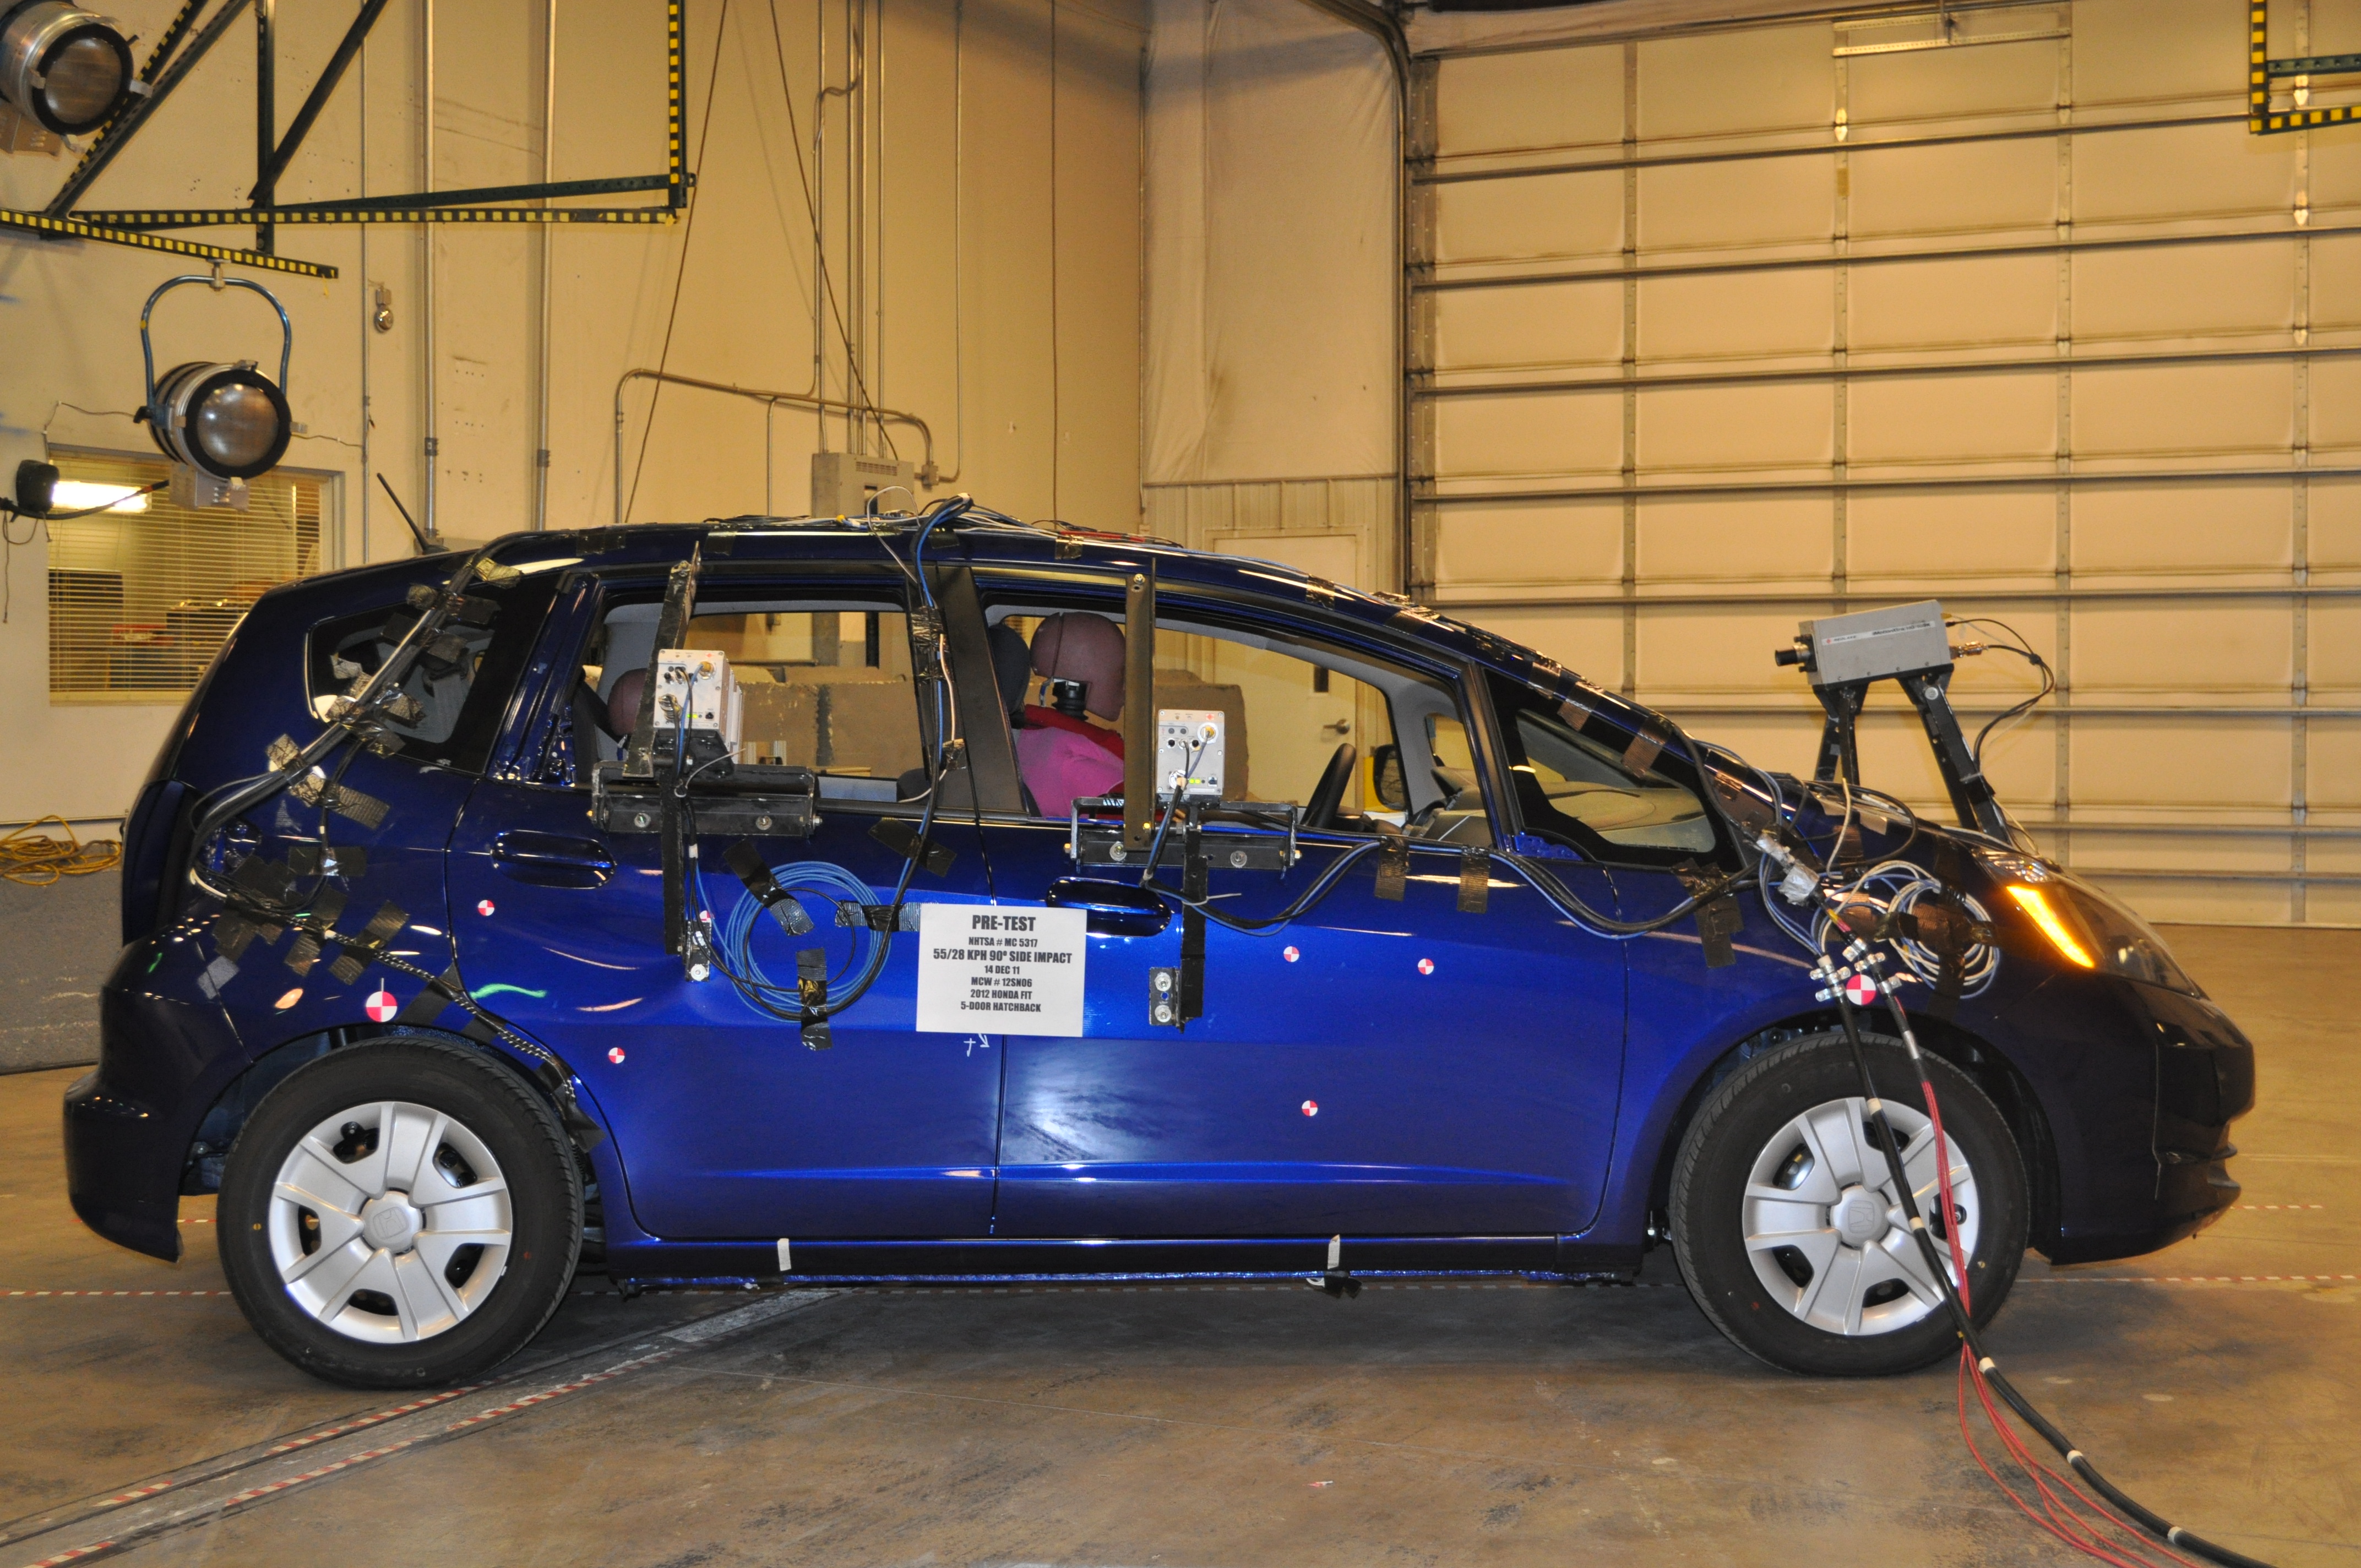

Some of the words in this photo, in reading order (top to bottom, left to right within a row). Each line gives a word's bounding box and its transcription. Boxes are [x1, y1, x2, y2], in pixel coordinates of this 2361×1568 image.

[972, 914, 1036, 932] PRE-TEST
[969, 937, 995, 946] NHTSA
[1005, 938, 1017, 947] MC
[1019, 938, 1038, 948] 5317
[933, 948, 965, 960] 55/28
[967, 950, 987, 961] KPH
[1009, 951, 1032, 962] SIDE
[1034, 952, 1072, 963] IMPACT
[984, 965, 993, 973] 14
[995, 966, 1010, 974] DEC
[1012, 966, 1020, 974] 11
[971, 977, 992, 986] MCW
[1002, 978, 1032, 987] 12SN06
[970, 989, 989, 998] 2012
[992, 989, 1019, 999] HONDA
[1021, 990, 1032, 1000] FIT
[960, 1001, 991, 1011] 5-DOOR
[993, 1002, 1042, 1012] HATCHBACK
